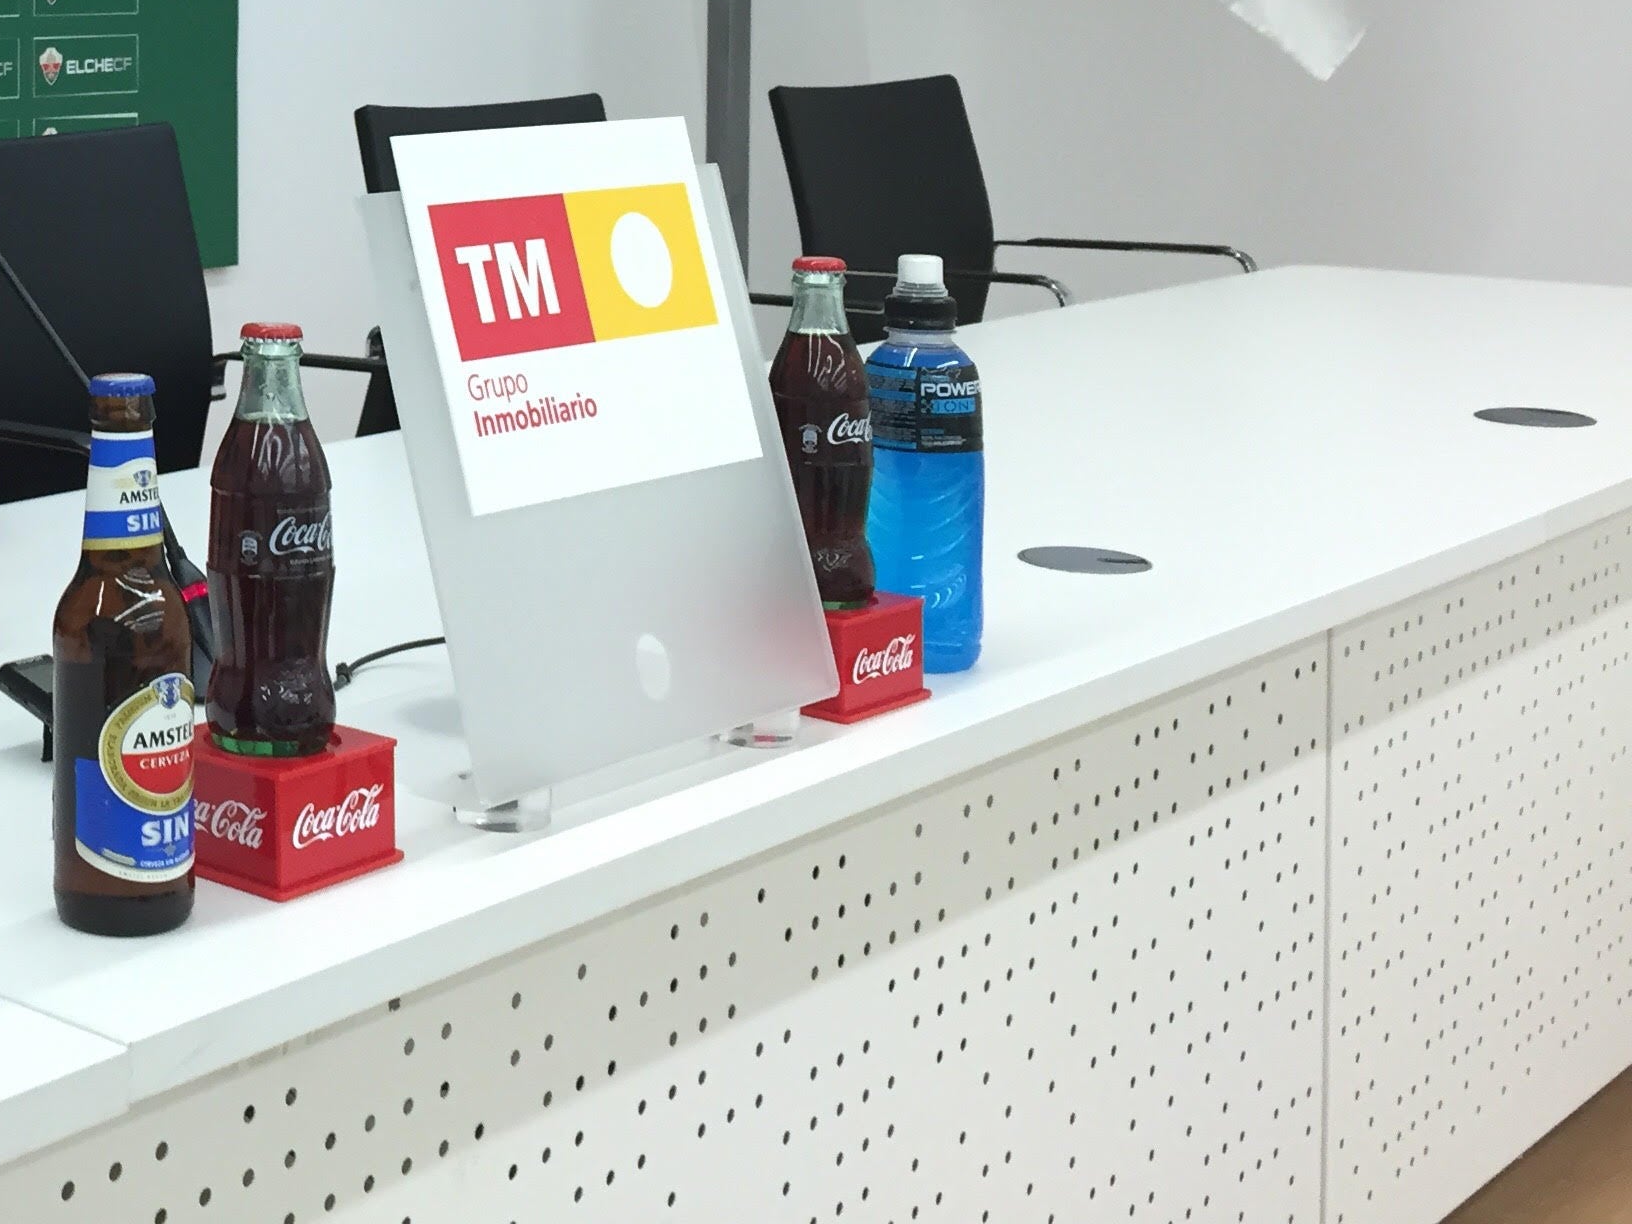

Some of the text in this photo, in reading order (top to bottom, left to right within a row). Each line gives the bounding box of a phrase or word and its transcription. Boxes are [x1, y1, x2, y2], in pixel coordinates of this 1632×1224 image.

[66, 58, 132, 75] ELCHECF
[455, 238, 561, 325] TM
[467, 371, 529, 405] Grupo
[473, 396, 599, 438] Inmobiliario
[120, 487, 159, 504] AMSTE
[127, 511, 160, 533] SIN
[853, 634, 916, 685] Coca-Cola
[133, 723, 193, 750] AMSTEL
[139, 749, 191, 770] CERVEZA
[141, 812, 190, 847] SIN
[292, 783, 384, 850] Coca-Cola
